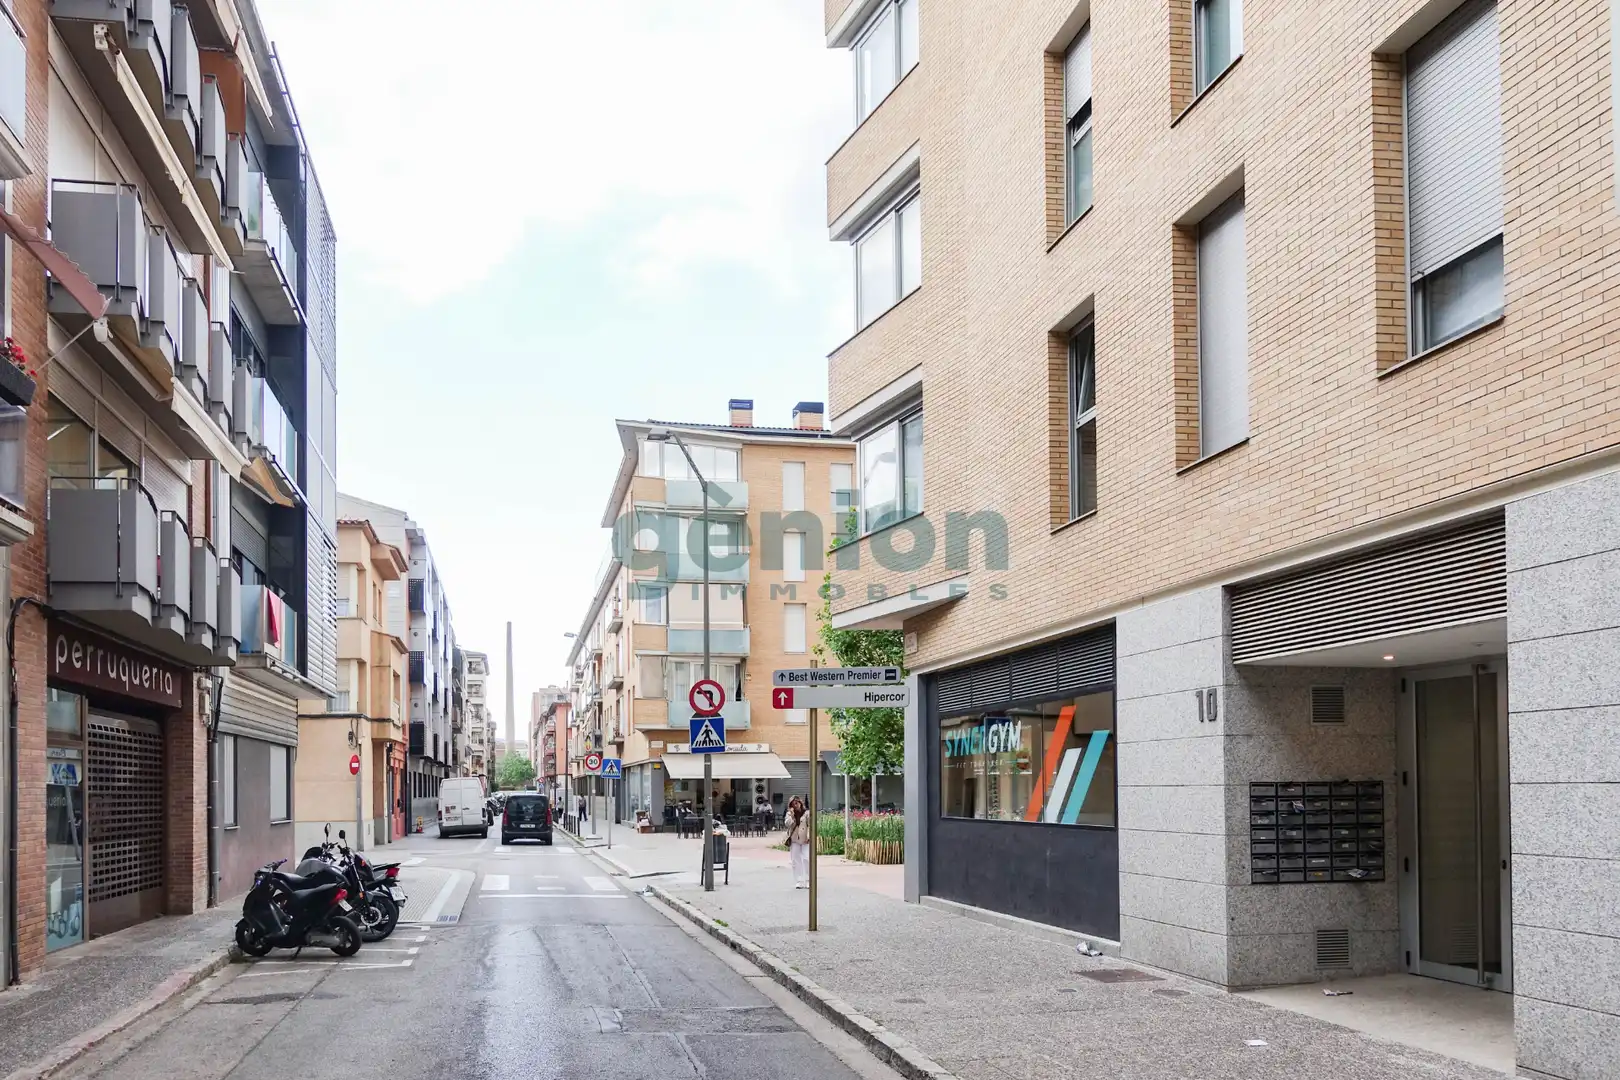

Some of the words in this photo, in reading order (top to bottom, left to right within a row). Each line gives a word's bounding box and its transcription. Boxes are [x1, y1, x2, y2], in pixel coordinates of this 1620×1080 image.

[55, 634, 173, 695] perruqueria
[788, 672, 808, 682] Best
[810, 671, 845, 681] Western
[847, 670, 882, 680] Premier
[864, 692, 905, 704] Hipercor
[1195, 688, 1218, 722] 10
